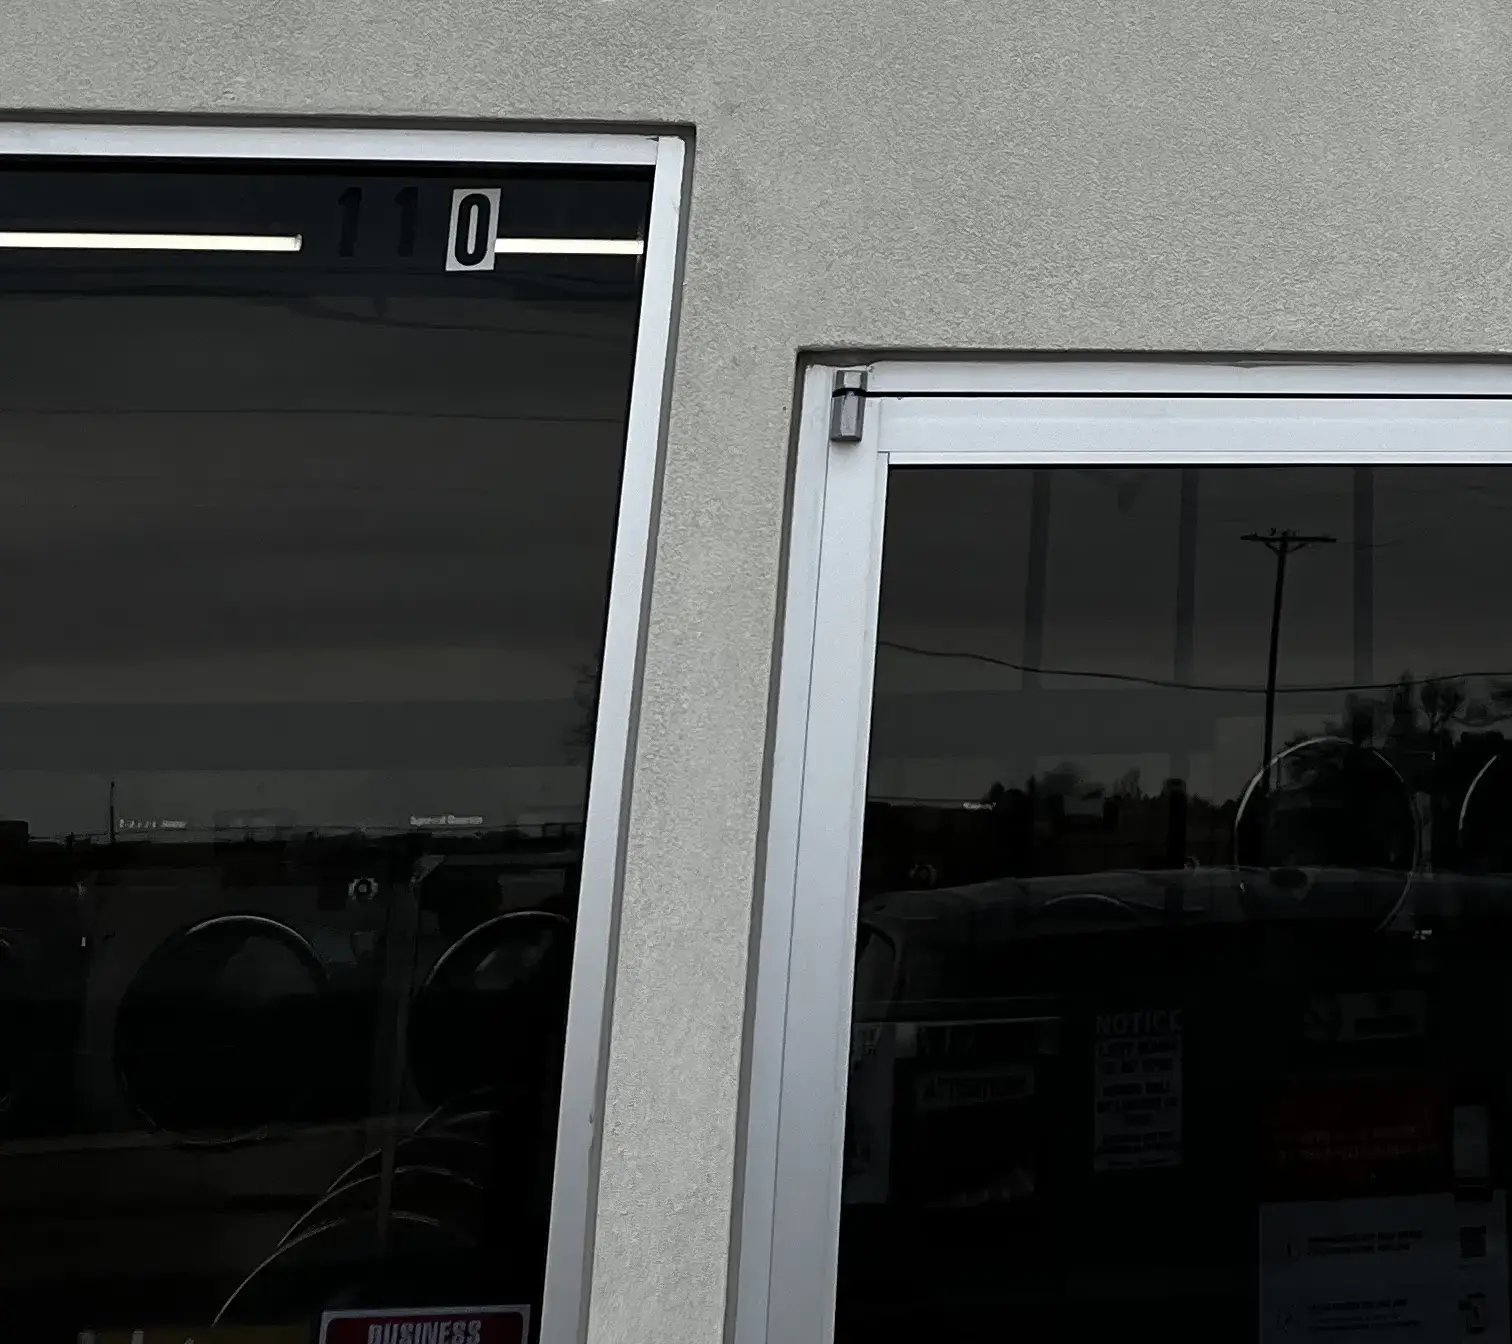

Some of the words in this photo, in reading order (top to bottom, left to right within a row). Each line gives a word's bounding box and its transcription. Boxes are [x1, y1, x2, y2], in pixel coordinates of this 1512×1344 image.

[337, 186, 491, 266] 110
[1095, 1009, 1182, 1035] NOTICE
[368, 1320, 482, 1344] BUSINESS
